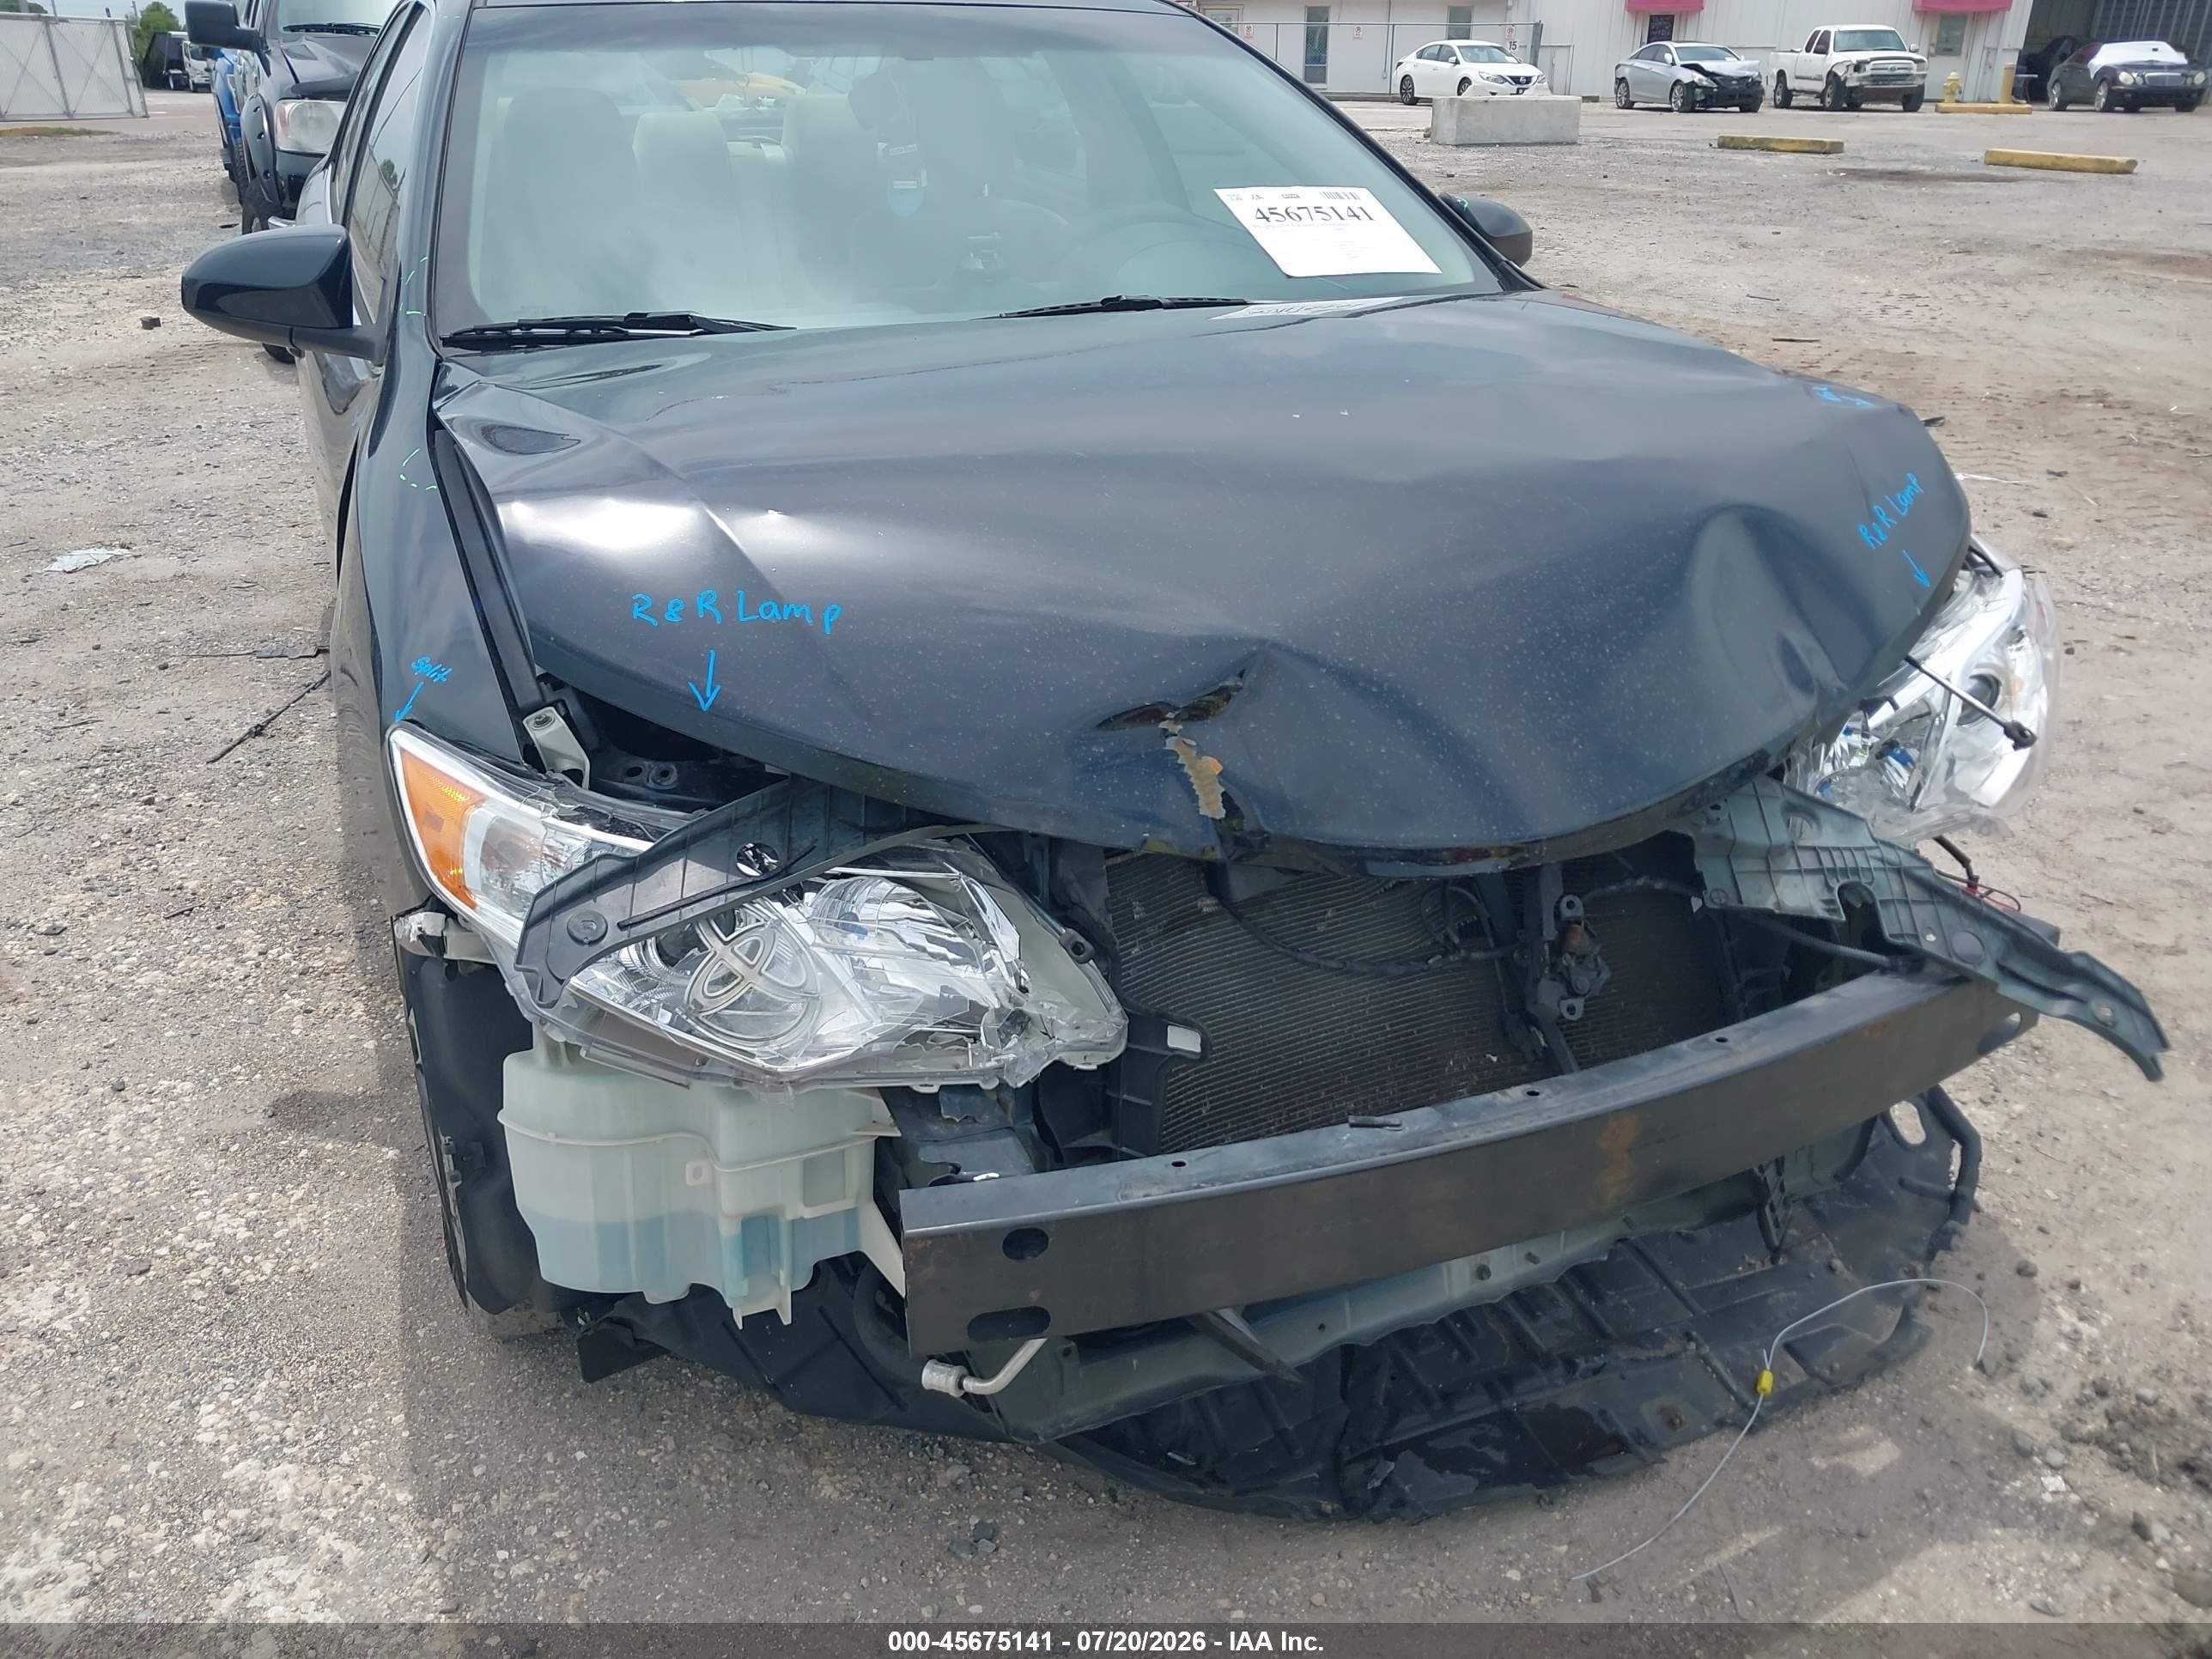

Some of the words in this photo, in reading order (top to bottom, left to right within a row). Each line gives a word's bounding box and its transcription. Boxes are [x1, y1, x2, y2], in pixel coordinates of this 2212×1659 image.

[1509, 40, 1518, 51] 15
[1255, 205, 1377, 223] 45675141
[1883, 471, 1924, 517] Lamp
[737, 590, 843, 635] Lamp
